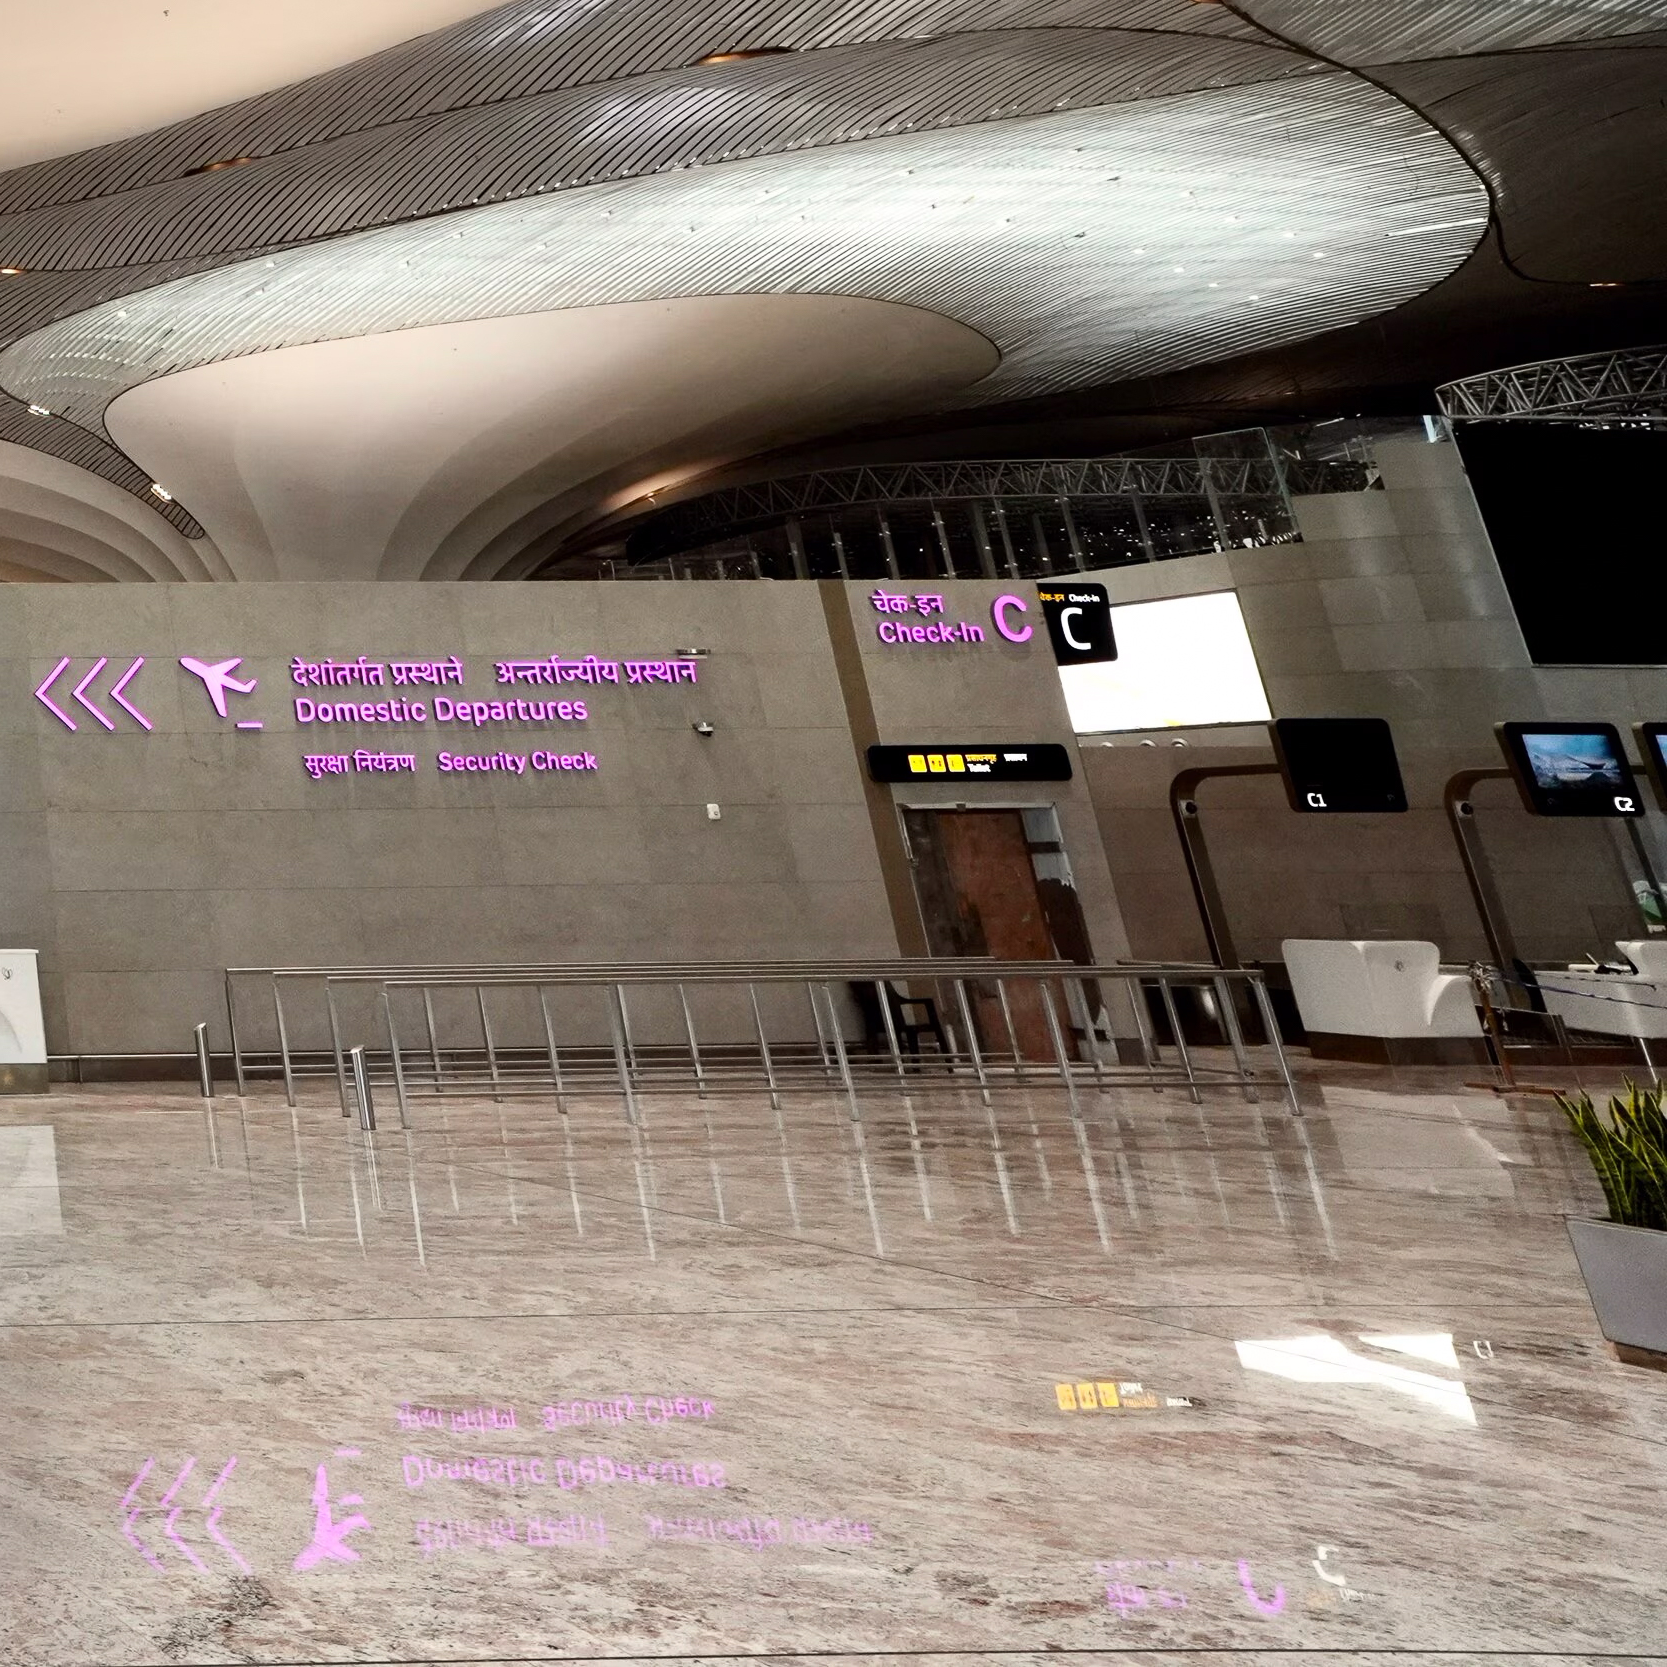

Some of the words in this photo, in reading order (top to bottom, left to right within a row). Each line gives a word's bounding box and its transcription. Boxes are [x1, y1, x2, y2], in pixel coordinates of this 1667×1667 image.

[872, 589, 943, 616] चेक-इन
[994, 595, 1033, 642] C
[1061, 607, 1091, 650] C
[291, 656, 384, 686] देशांतर्गत
[389, 656, 463, 686] प्रस्थाने
[624, 660, 697, 683] प्रस्थान
[295, 697, 427, 723] Domestic
[434, 697, 588, 726] Departures
[304, 754, 349, 778] सुरक्षा
[353, 750, 416, 772] नियंत्रण
[437, 751, 526, 775] Security
[531, 752, 598, 770] Check
[1307, 793, 1327, 808] C1
[1613, 797, 1635, 811] C2
